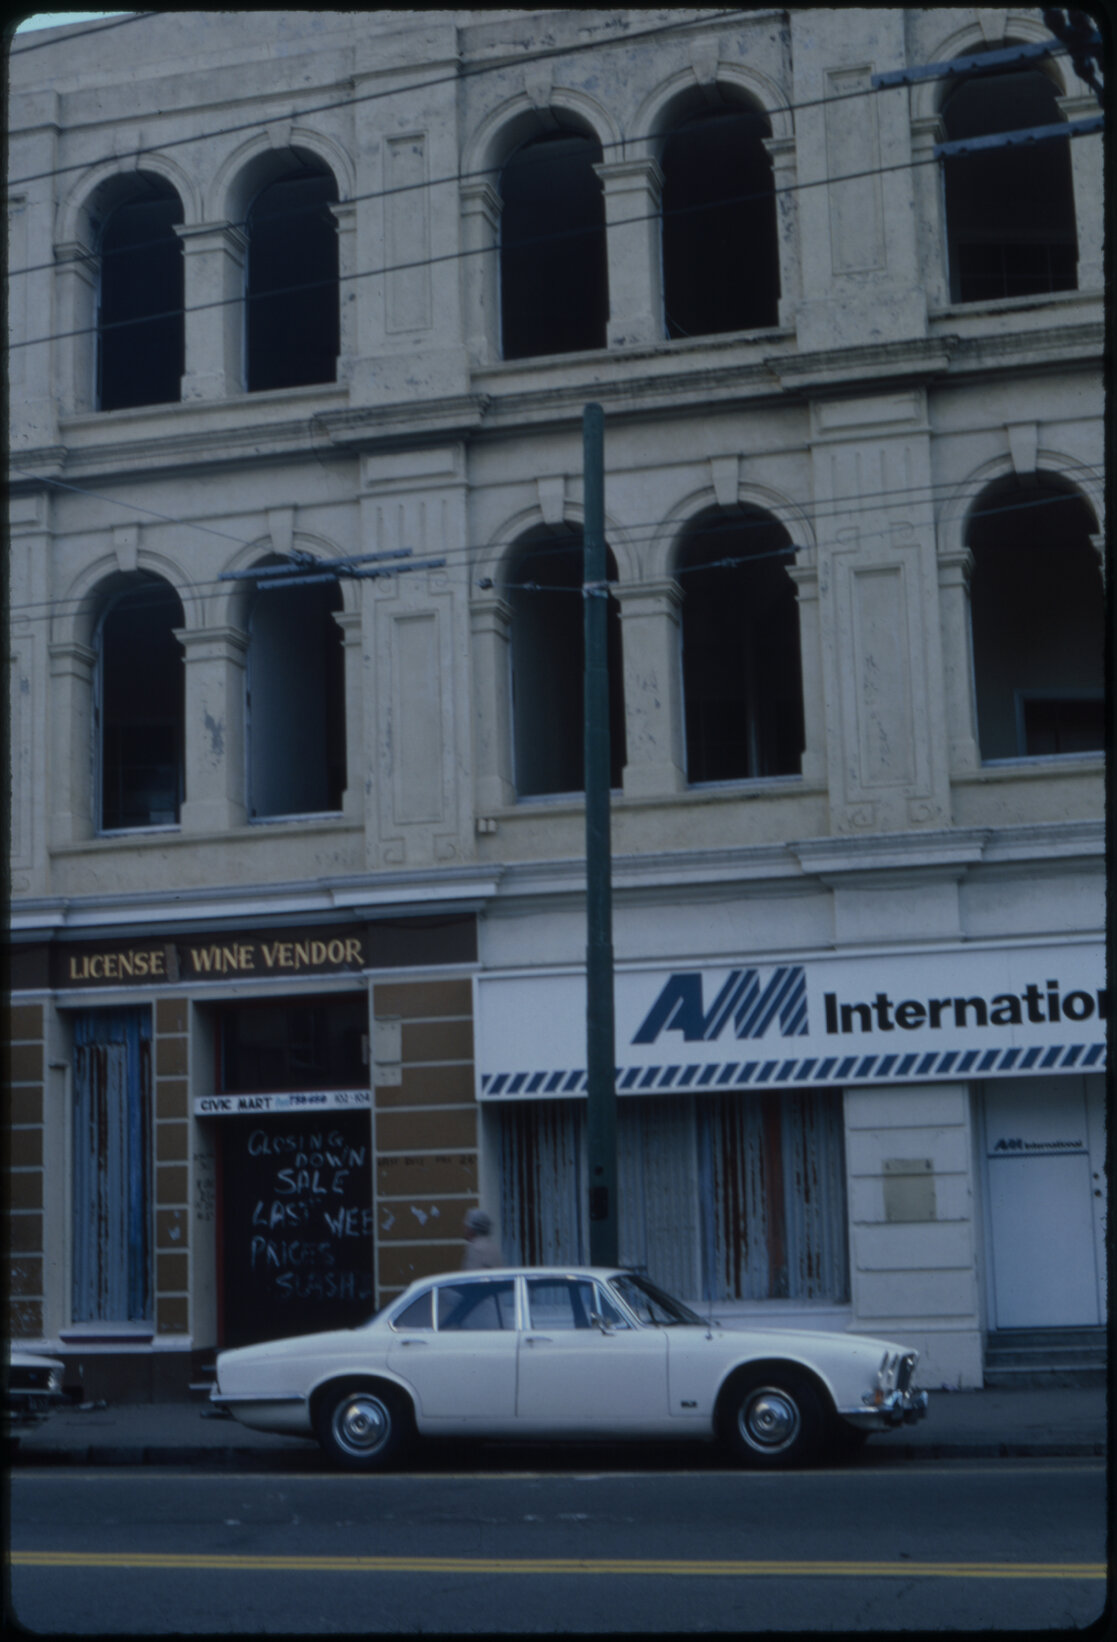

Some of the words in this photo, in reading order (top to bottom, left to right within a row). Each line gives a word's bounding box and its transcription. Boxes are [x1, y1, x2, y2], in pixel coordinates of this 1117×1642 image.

[69, 949, 172, 980] LICENSE
[190, 943, 254, 973] WINE
[261, 939, 365, 969] VENDOR
[823, 979, 1106, 1034] Internatio
[238, 1097, 273, 1111] MART
[248, 1129, 345, 1157] CLOSING
[295, 1146, 365, 1169] DOWN
[274, 1167, 350, 1194] SALE
